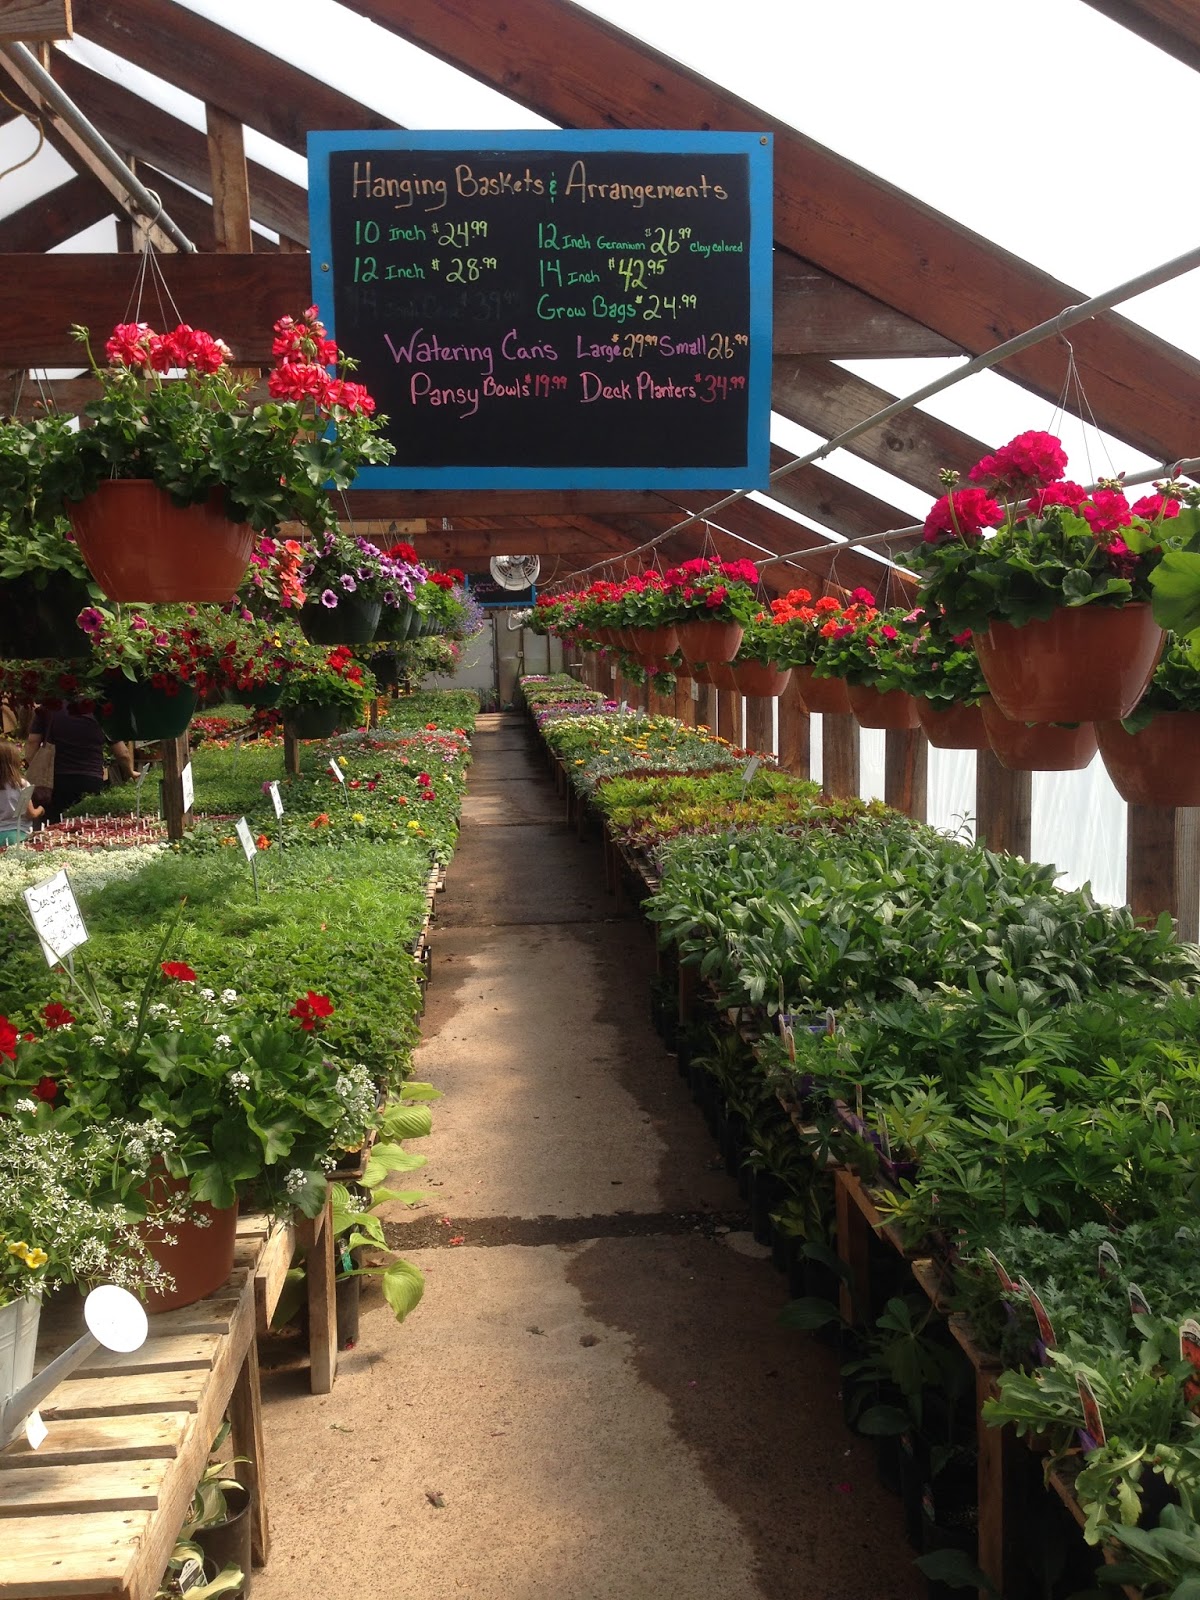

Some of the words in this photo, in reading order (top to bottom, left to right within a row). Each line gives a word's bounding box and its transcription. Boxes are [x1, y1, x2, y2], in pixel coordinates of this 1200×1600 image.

[353, 161, 448, 212] Hanging
[455, 164, 545, 197] Baskets
[565, 160, 728, 208] Arrangements
[355, 220, 380, 245] 10
[537, 222, 560, 250] 12
[562, 234, 591, 250] Inch
[597, 235, 646, 250] Geranium
[354, 257, 378, 283] 12
[385, 263, 425, 280] Inch
[539, 259, 563, 288] 14
[567, 270, 600, 286] Inch
[537, 294, 586, 320] Grow
[592, 295, 636, 324] Bags
[384, 327, 494, 376] Watering
[501, 328, 558, 361] Cans
[576, 335, 622, 363] Large
[659, 335, 707, 357] Small
[410, 372, 478, 419] Pansy
[483, 376, 530, 399] Bowls
[579, 371, 632, 402] Deck
[636, 371, 696, 400] Planters
